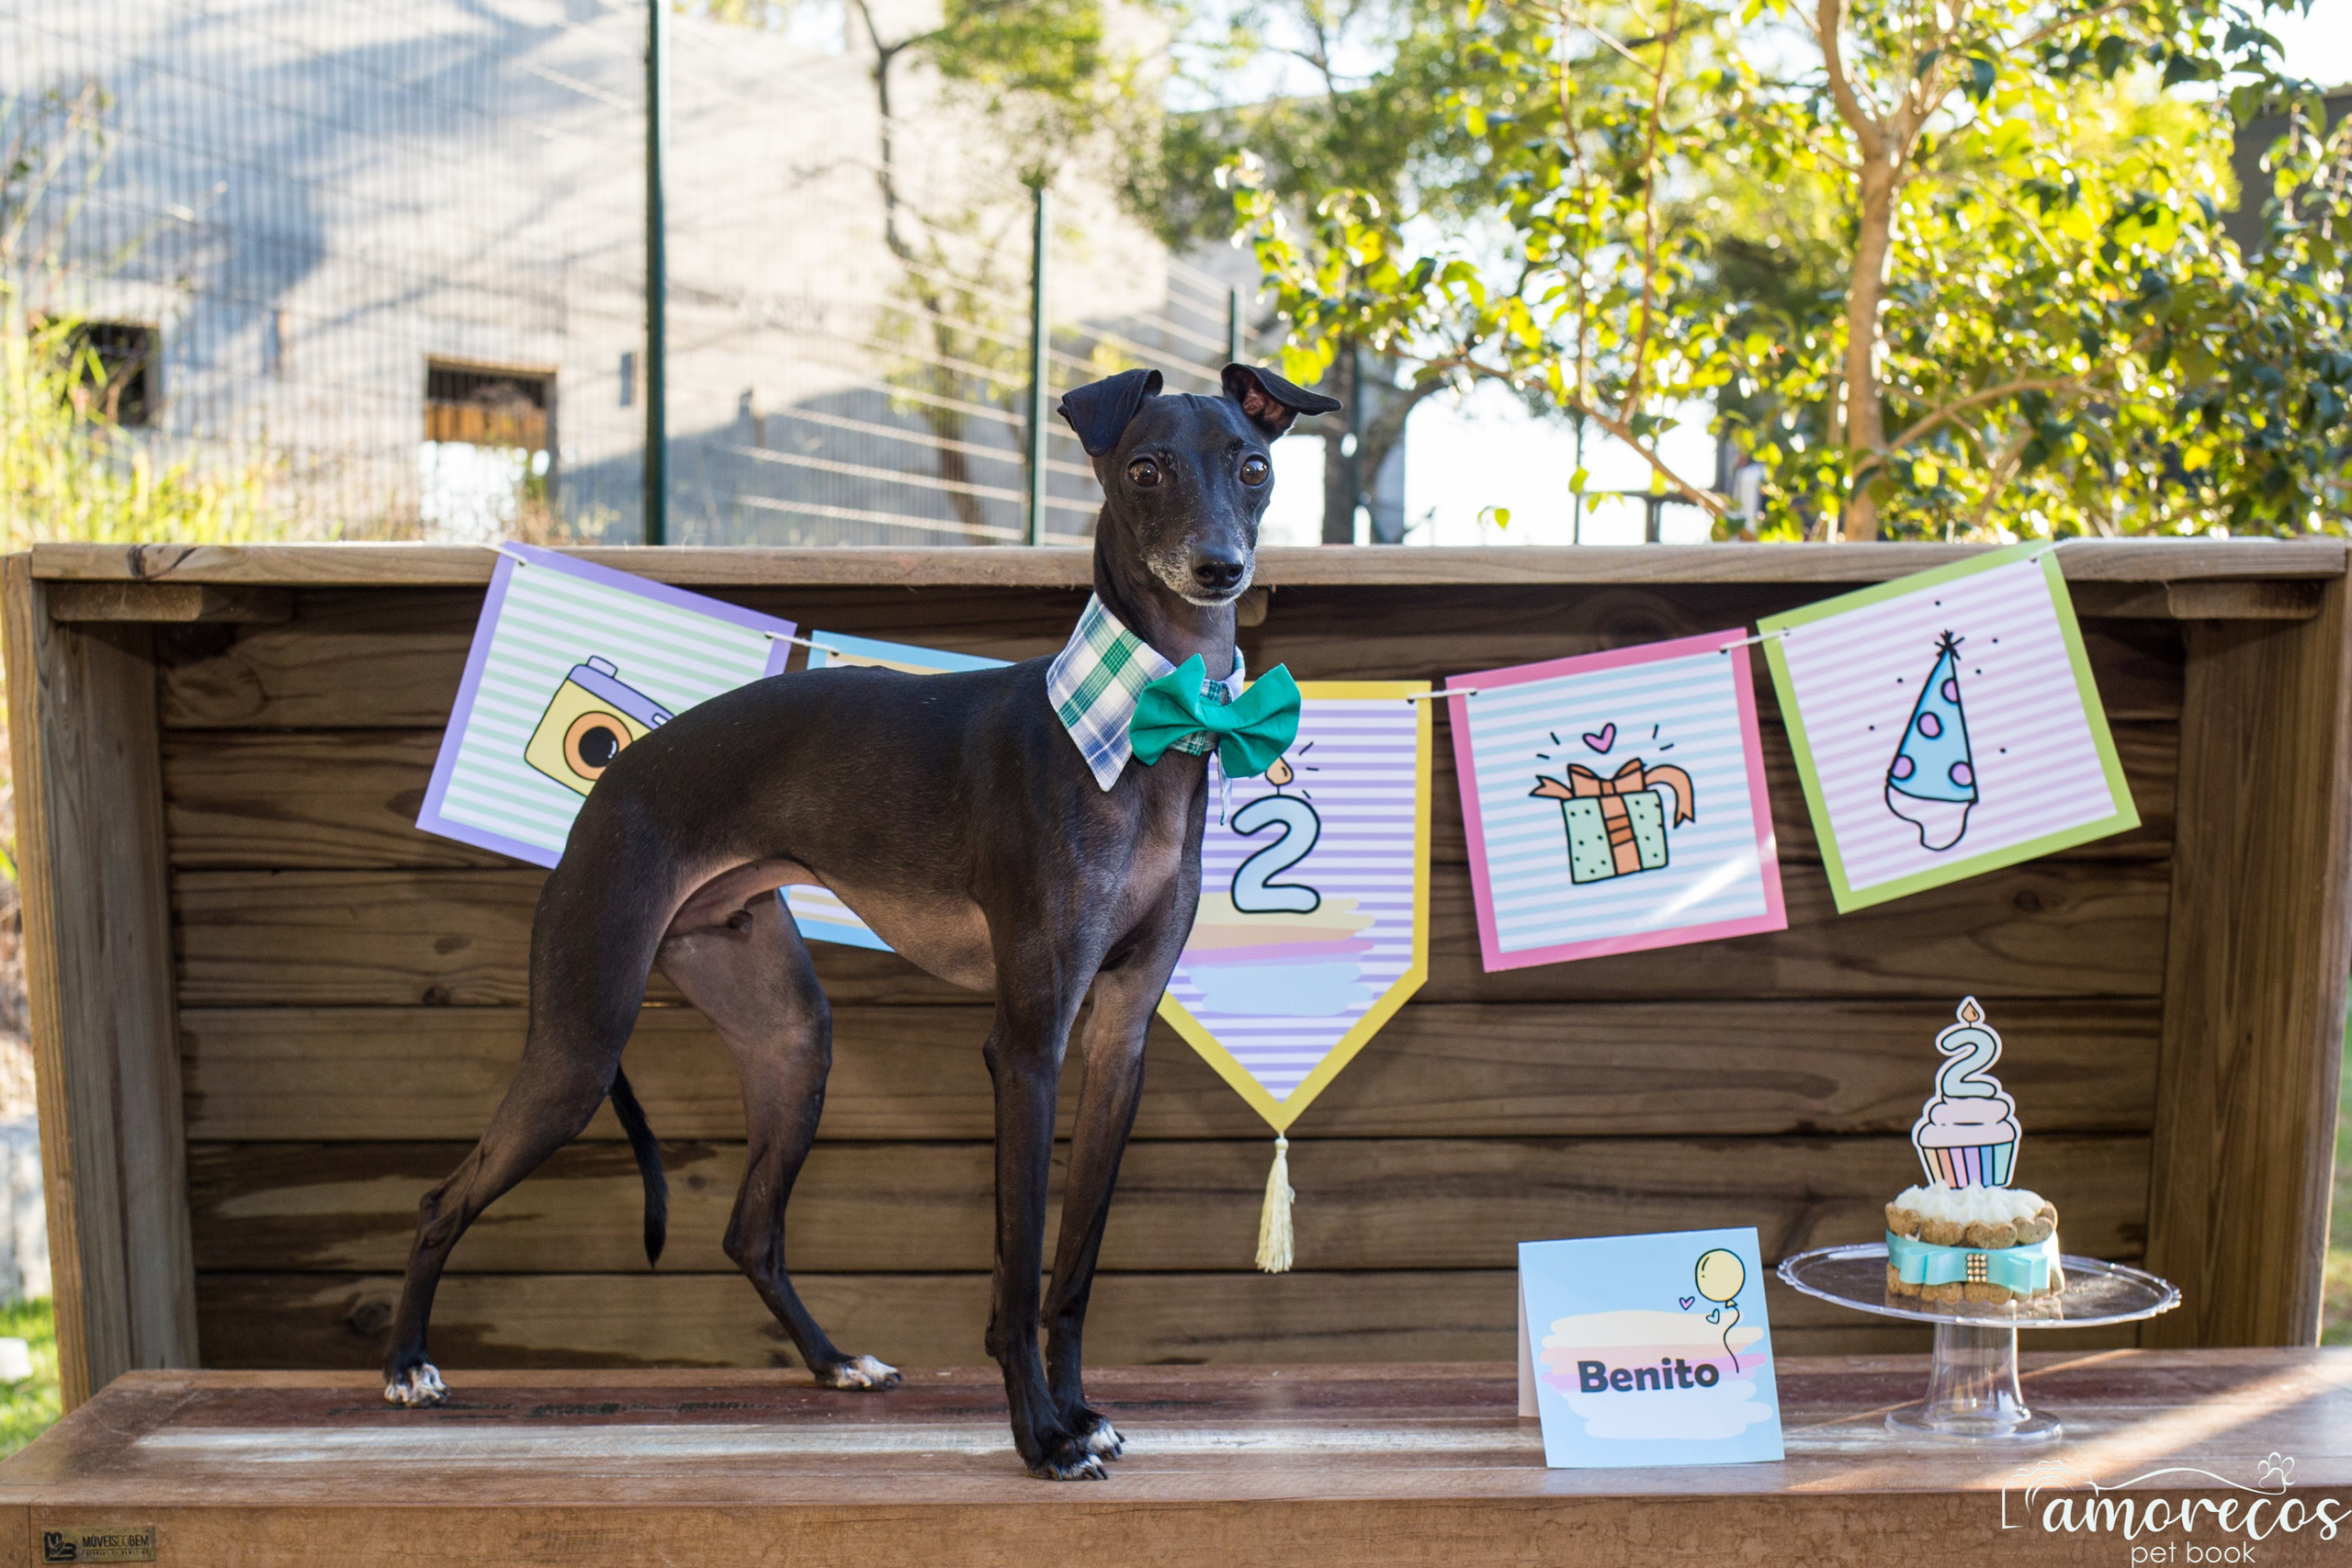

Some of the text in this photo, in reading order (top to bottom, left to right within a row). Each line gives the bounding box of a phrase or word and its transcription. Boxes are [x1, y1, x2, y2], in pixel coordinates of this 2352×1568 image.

[1231, 795, 1321, 914] 2
[1940, 1028, 1997, 1098] 2
[1577, 1358, 1719, 1393] Benito
